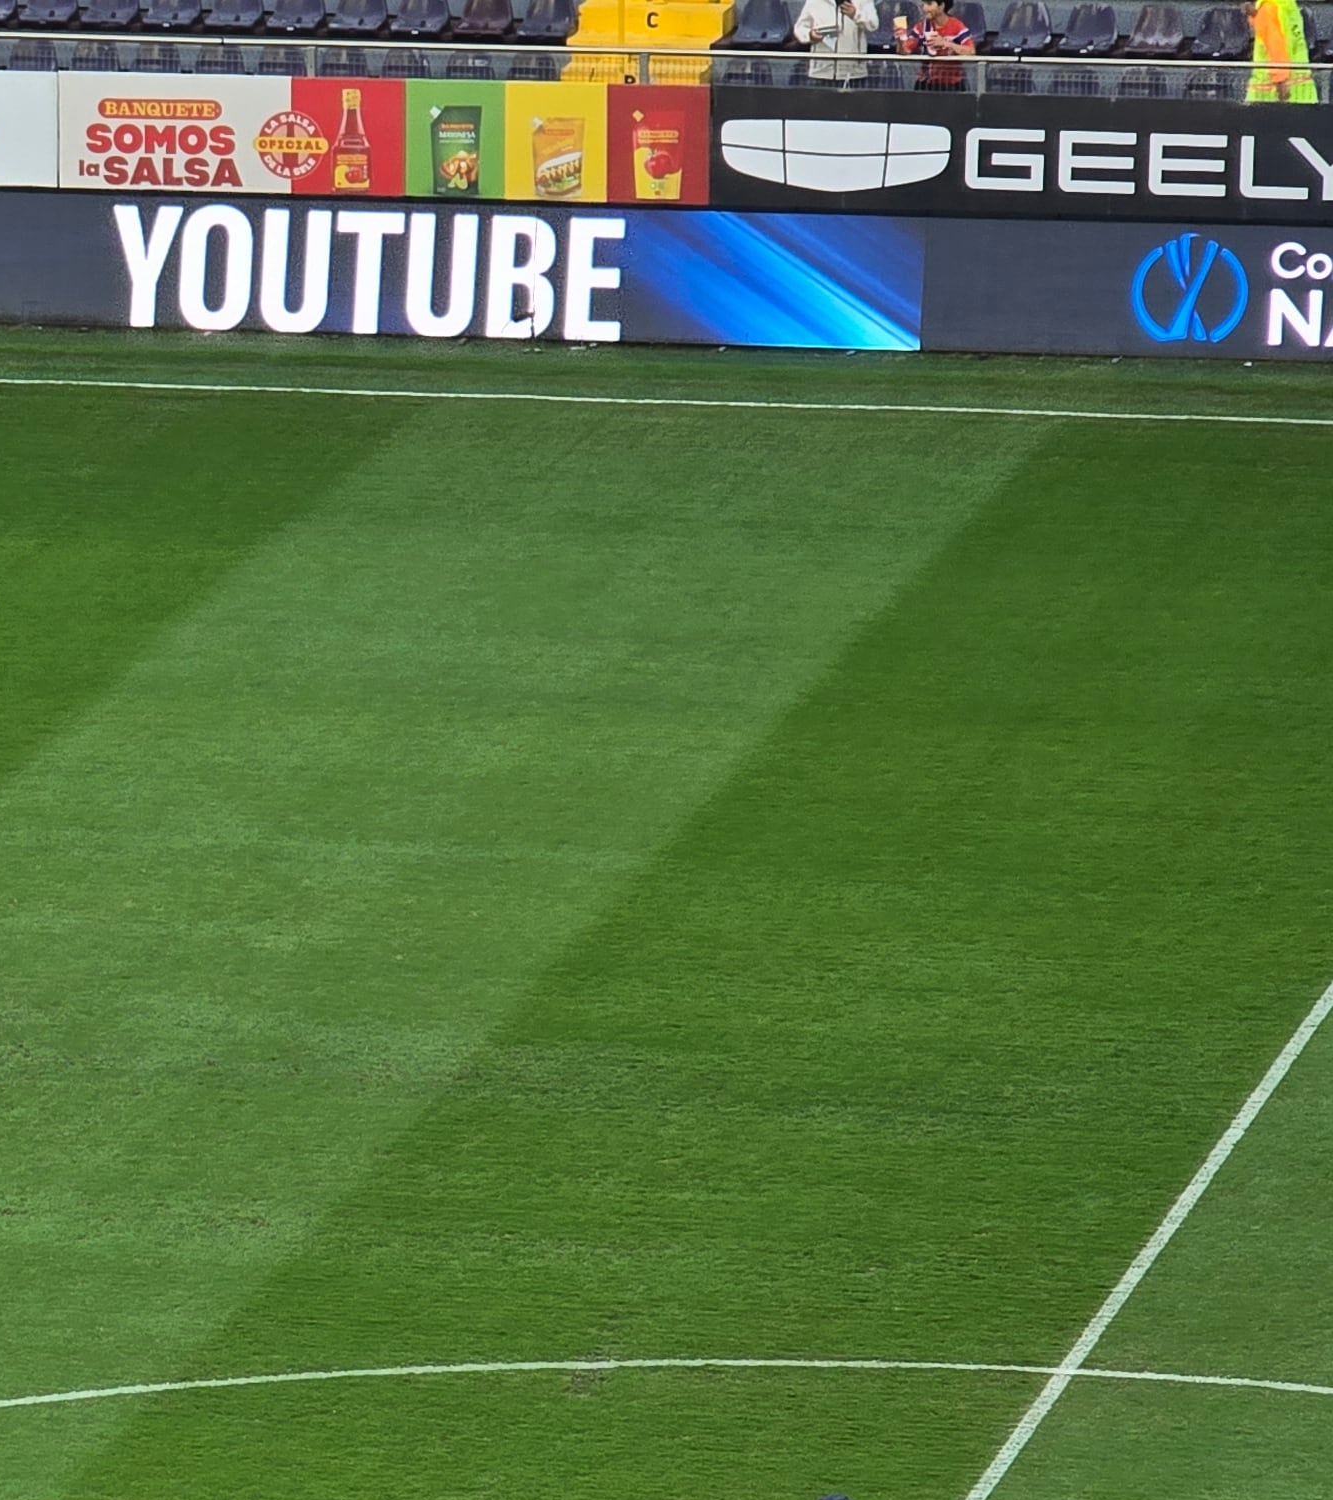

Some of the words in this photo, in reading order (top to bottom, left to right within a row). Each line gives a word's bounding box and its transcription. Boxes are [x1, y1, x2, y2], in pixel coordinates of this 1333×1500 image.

[647, 12, 659, 28] C
[104, 101, 216, 117] BANQUETE
[86, 123, 236, 156] SOMOS
[264, 119, 279, 134] LA
[259, 139, 323, 150] OFICIAL
[79, 160, 100, 177] la
[103, 156, 243, 187] SALSA
[965, 127, 1333, 200] GEELY
[112, 204, 627, 342] YOUTUBE
[1267, 288, 1333, 347] N
